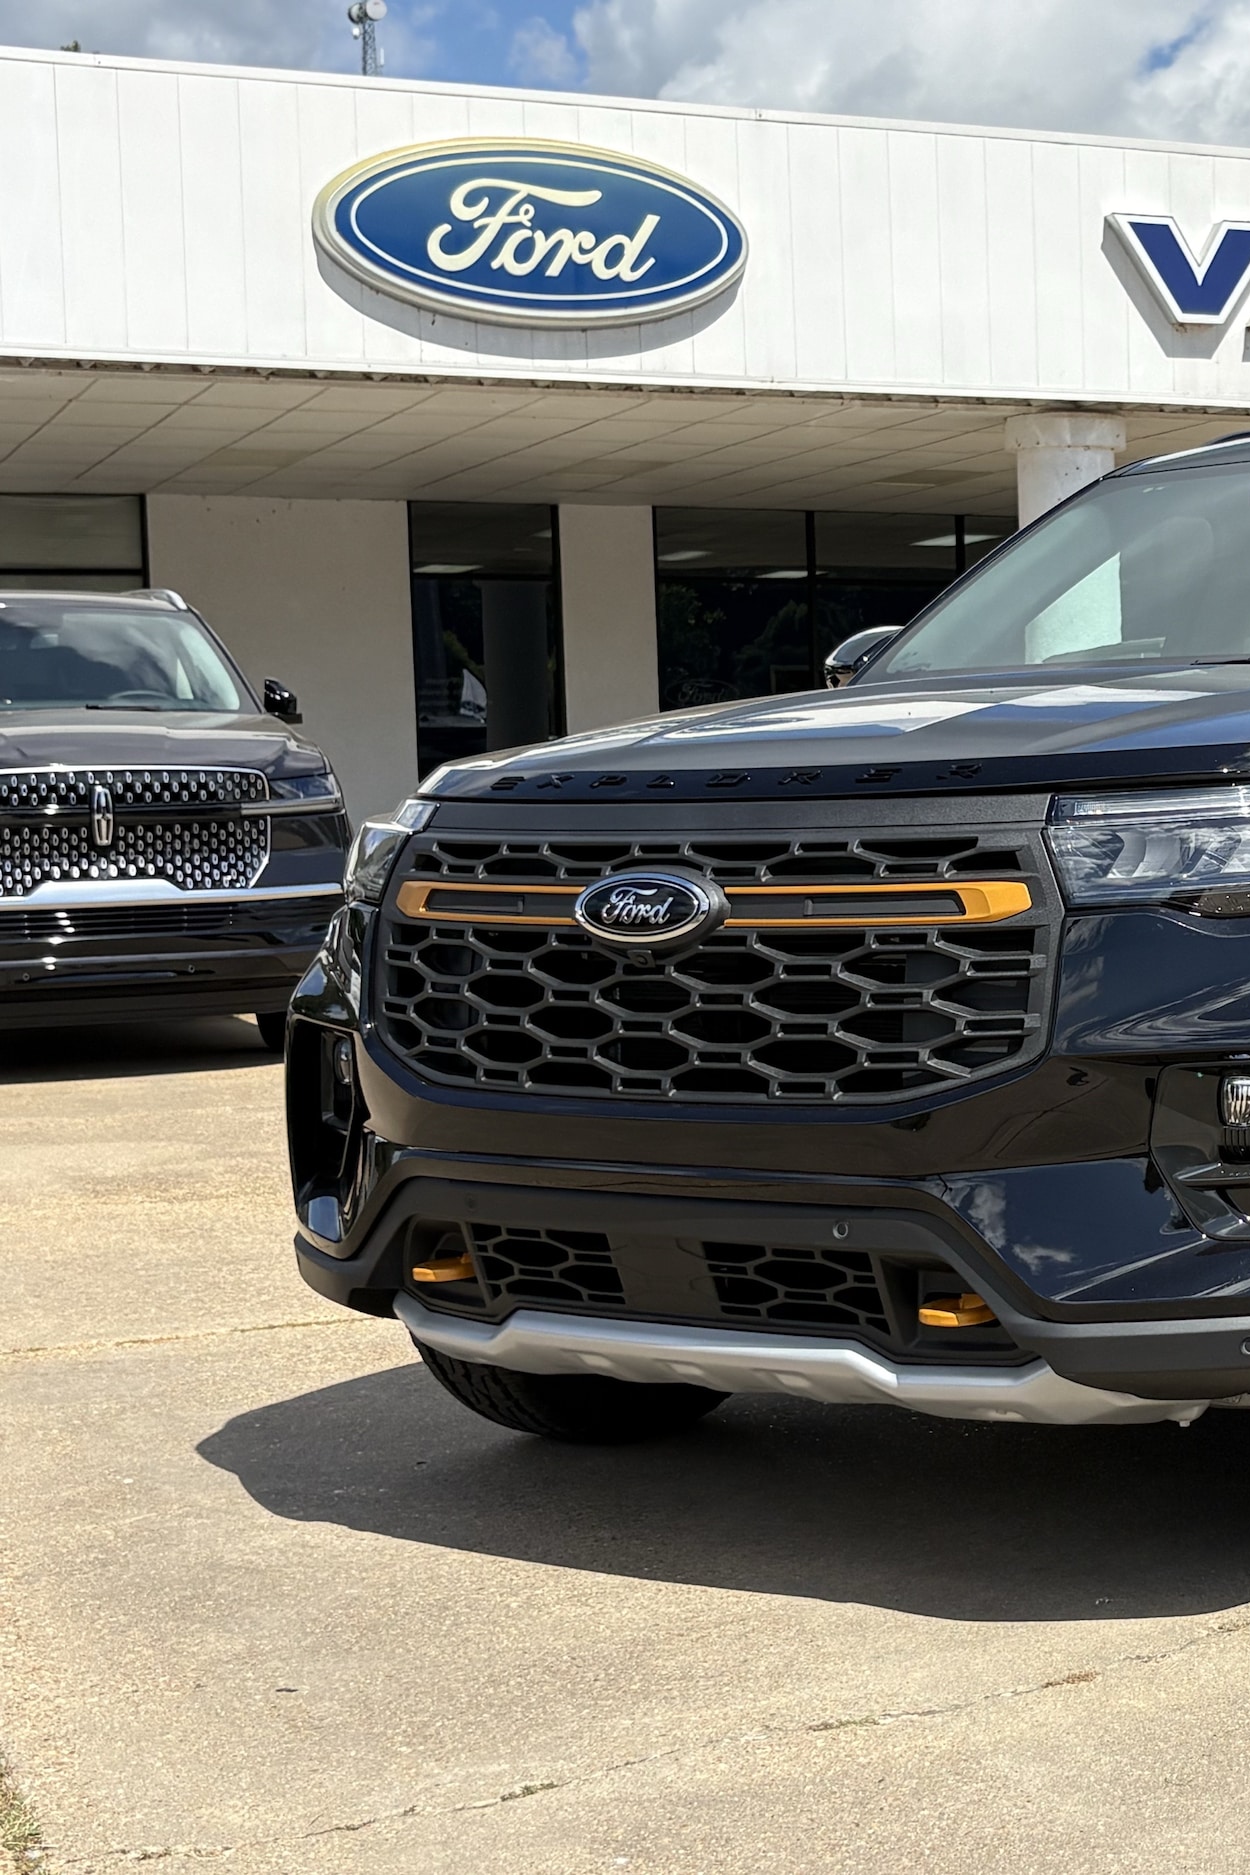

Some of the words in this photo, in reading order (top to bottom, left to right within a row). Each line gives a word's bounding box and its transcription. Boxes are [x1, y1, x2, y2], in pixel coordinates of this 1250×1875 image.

[426, 177, 662, 283] Ford
[490, 764, 983, 791] EXPLORER
[601, 886, 674, 925] Ford
